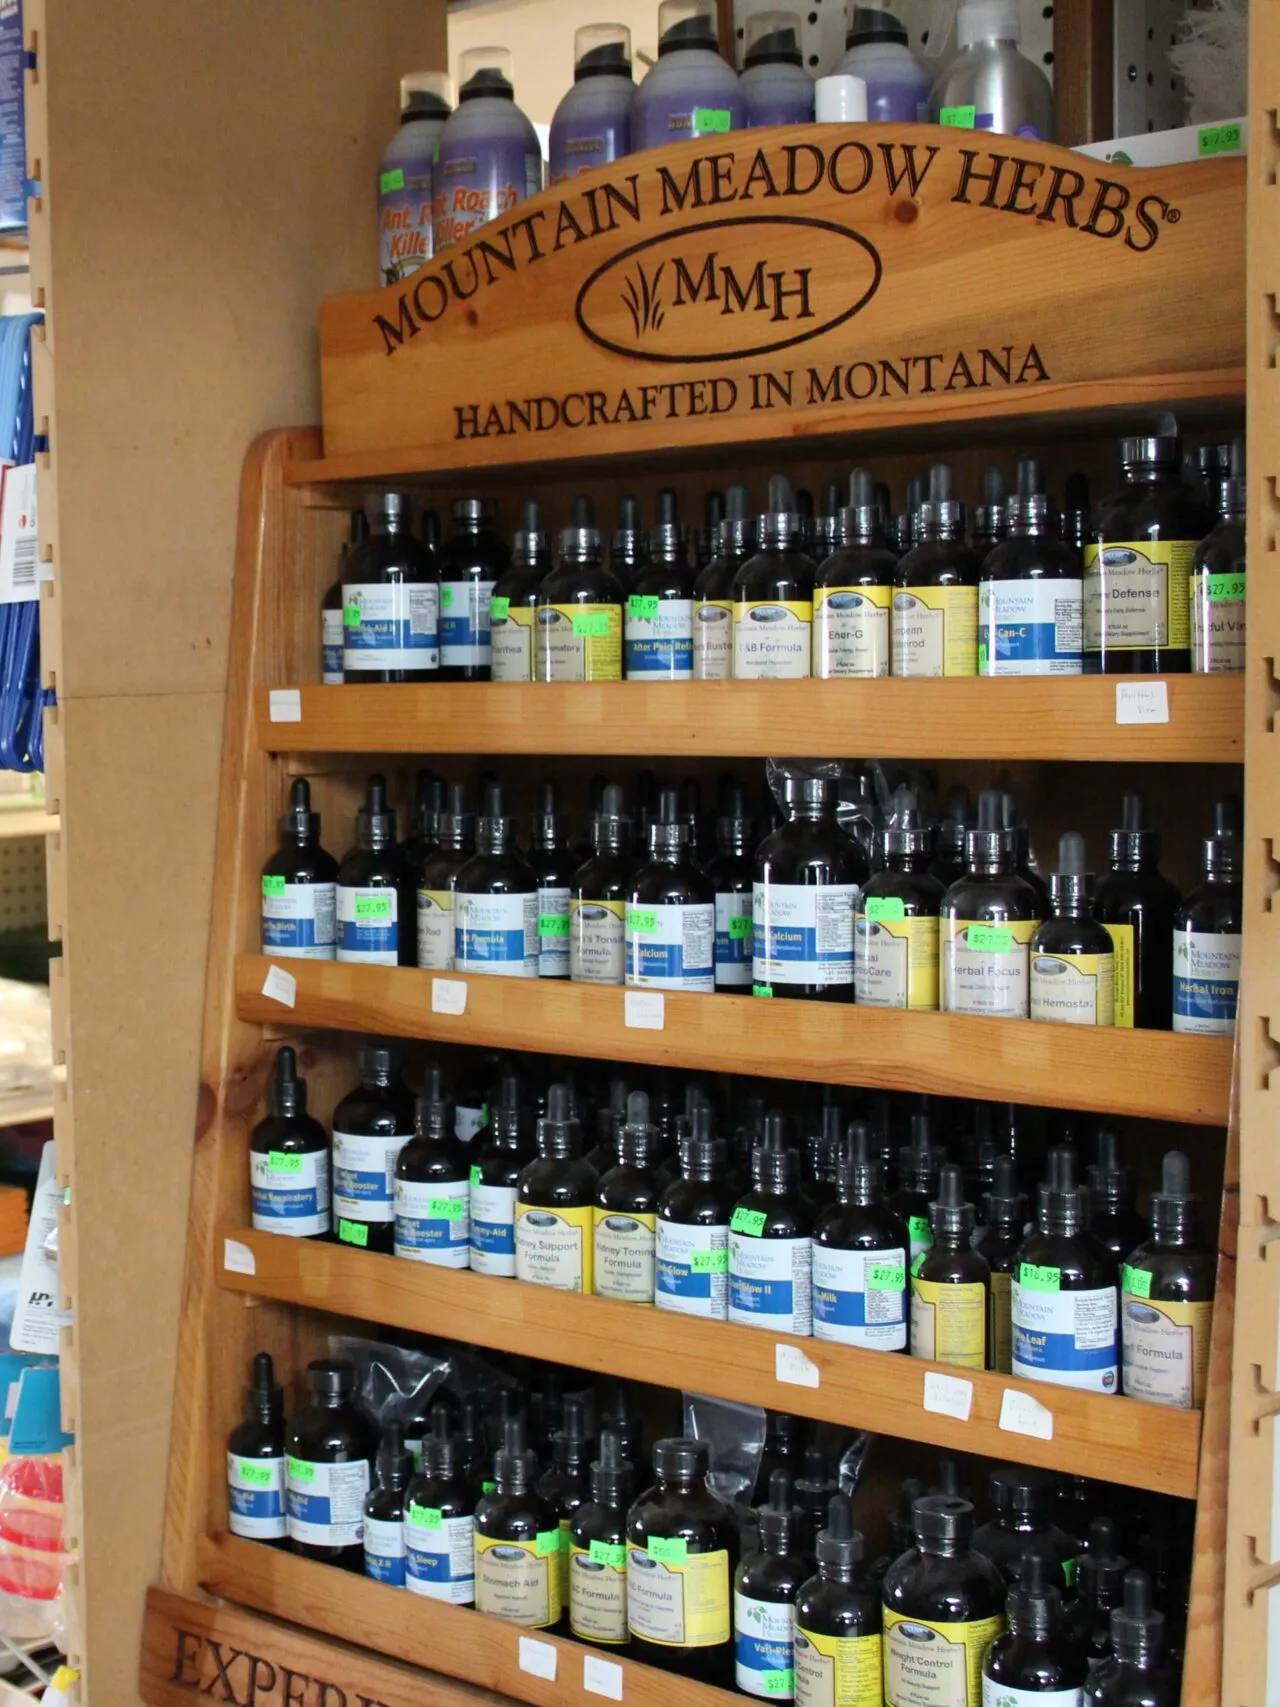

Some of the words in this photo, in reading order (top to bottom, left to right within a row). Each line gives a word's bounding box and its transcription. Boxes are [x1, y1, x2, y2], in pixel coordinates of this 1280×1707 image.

[372, 174, 641, 356] MOUNTAIN
[656, 142, 941, 216] MEADOW
[390, 230, 431, 258] Kille
[671, 252, 815, 321] MMH
[454, 377, 737, 439] HANDCRAFTED
[749, 371, 794, 409] IN
[806, 343, 1051, 404] MONTANA
[1112, 588, 1160, 600] Defense
[1207, 582, 1246, 596] $27.95
[828, 630, 864, 640] Ener-G
[759, 641, 803, 653] Formula
[987, 966, 1021, 977] Focus
[1179, 981, 1209, 994] Herbal
[1211, 984, 1233, 995] Iron
[538, 1240, 579, 1252] Support
[622, 1247, 656, 1259] Toning
[524, 1251, 561, 1263] Formula
[604, 1256, 642, 1269] Formula
[1023, 1266, 1060, 1284] $16.95
[1027, 1334, 1048, 1347] Leaf
[1135, 1344, 1184, 1360] Formula
[482, 1573, 521, 1588] Stomach
[523, 1578, 539, 1588] Aid
[582, 1587, 620, 1601] Formula
[637, 1584, 673, 1601] Formula
[915, 1655, 954, 1669] Control
[900, 1663, 937, 1680] Formula
